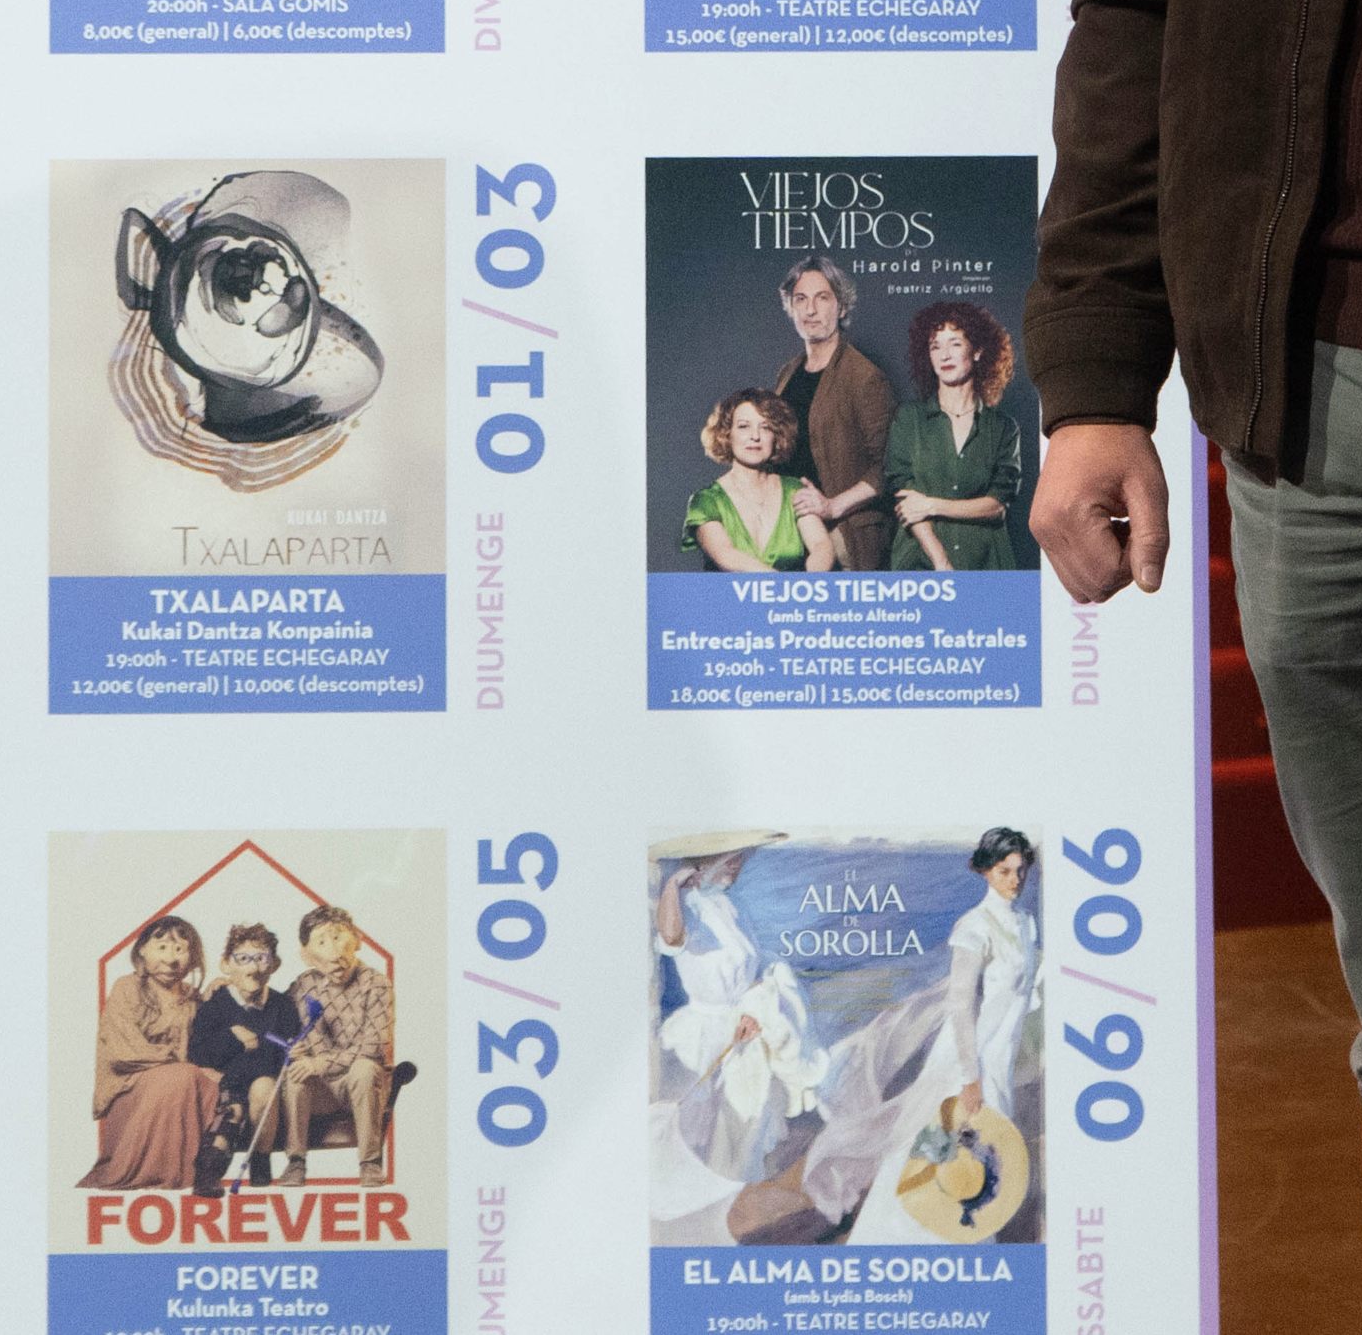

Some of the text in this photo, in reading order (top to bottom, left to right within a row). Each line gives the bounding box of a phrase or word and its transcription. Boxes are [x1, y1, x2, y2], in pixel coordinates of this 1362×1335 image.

[701, 0, 762, 20] 19:00h
[739, 171, 885, 211] VIEJOS
[741, 210, 935, 250] TIEMPOS
[852, 259, 993, 274] Harold Pinter
[461, 162, 559, 710] DIUMENGE 01/03
[149, 588, 345, 614] TXALAPARTA
[731, 578, 957, 603] VIEJOS TIEMPOS
[766, 607, 922, 625] (amb Ernesto Alterio)
[121, 619, 374, 645] Kukai Dantza Konpainia
[661, 626, 1028, 656] Entrecajas Producciones Teatrales
[704, 656, 986, 678] 19:00h TEATRE ECHEGARAY
[798, 884, 905, 916] ALMA
[777, 927, 924, 960] SOROLLA
[463, 831, 561, 1148] 03/05
[1060, 827, 1157, 1143] 06/06
[87, 1189, 411, 1245] FOREVER
[177, 1264, 319, 1291] FOREVER
[683, 1256, 1013, 1285] EL ALMA DE SOROLLA
[166, 1296, 330, 1319] Kulunka Teatro
[783, 1288, 914, 1307] (amb Lydia Bosch)
[707, 1310, 991, 1334] 19:00h TEATRE ECHEGARAY
